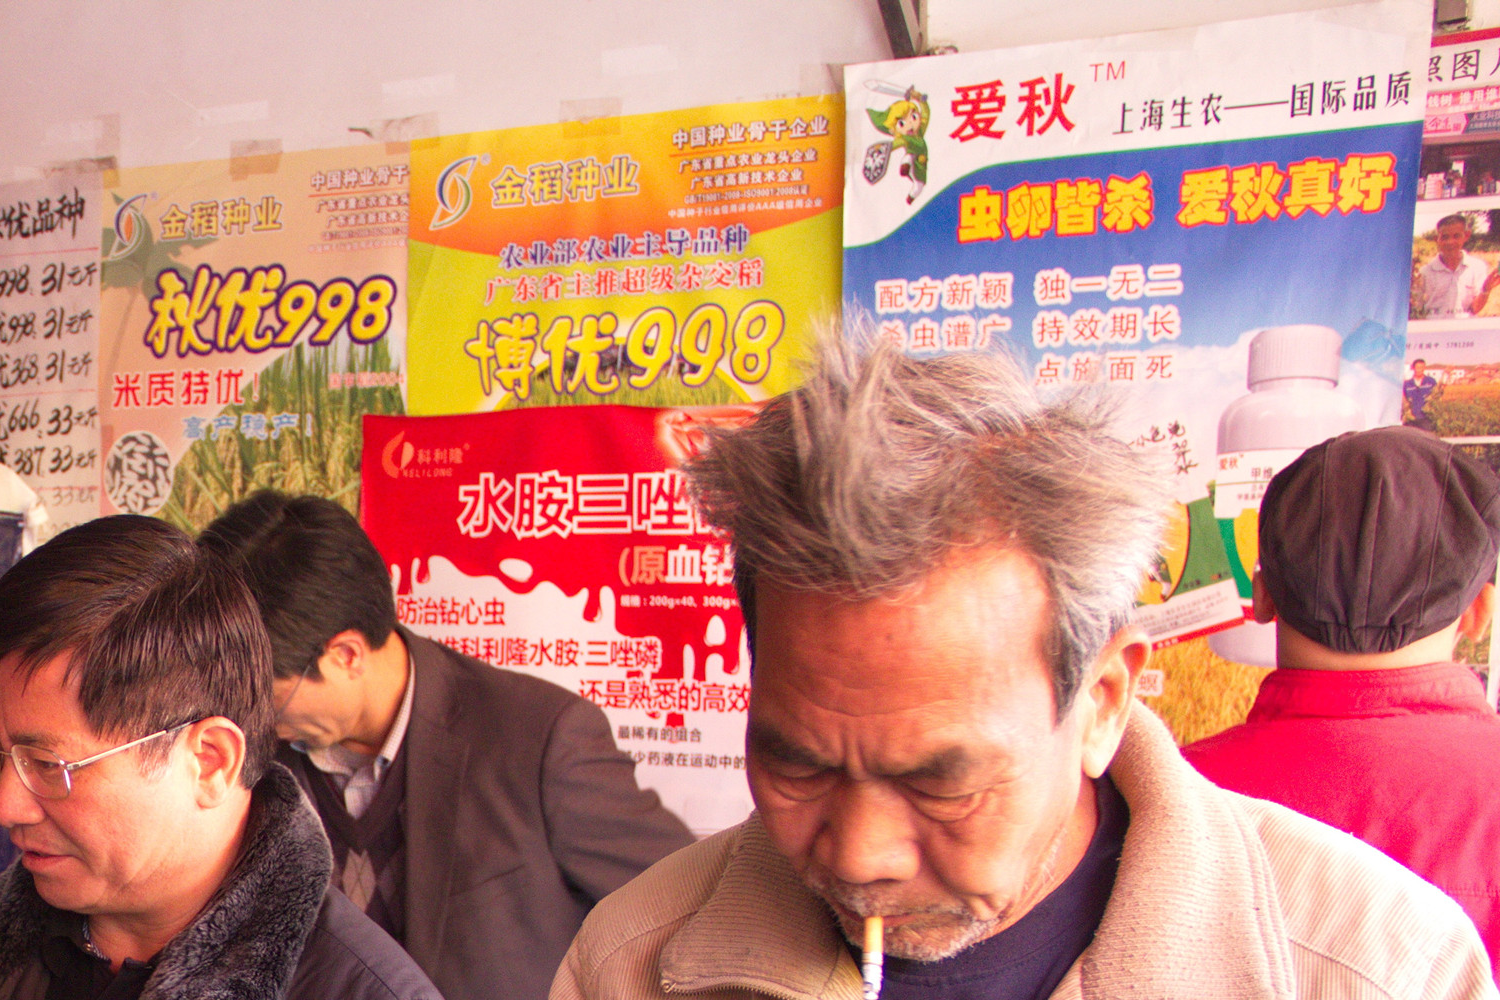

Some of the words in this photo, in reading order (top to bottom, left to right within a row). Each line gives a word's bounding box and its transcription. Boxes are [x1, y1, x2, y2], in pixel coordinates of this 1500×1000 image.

[1090, 60, 1126, 82] TM
[949, 71, 1076, 143] 爱秋
[671, 115, 829, 150] 中国种业骨干企业
[679, 147, 818, 174] 广东省重点农业龙头企业
[690, 167, 804, 190] 广东省高新技术企业
[490, 153, 640, 209] 金稻种业
[957, 172, 1155, 244] 虫卵皆杀
[1176, 152, 1397, 227] 爱秋真好
[159, 195, 284, 241] 金稻种业
[500, 223, 750, 271] 农业部农业主导品种
[483, 257, 765, 306] 广东省主推超级杂交稻
[878, 277, 1008, 309] 配方新颖
[1039, 269, 1177, 301] 独一无二
[145, 263, 397, 358] 秋优998
[1036, 310, 1175, 343] 持效期长
[464, 299, 786, 400] 博优998
[456, 469, 714, 541] 水胺三唑
[396, 597, 506, 626] 防治钻心虫
[578, 679, 752, 713] 还是熟悉的高效
[617, 725, 702, 743] 最稀有的组合
[627, 750, 747, 770] 少药液在运动中的
